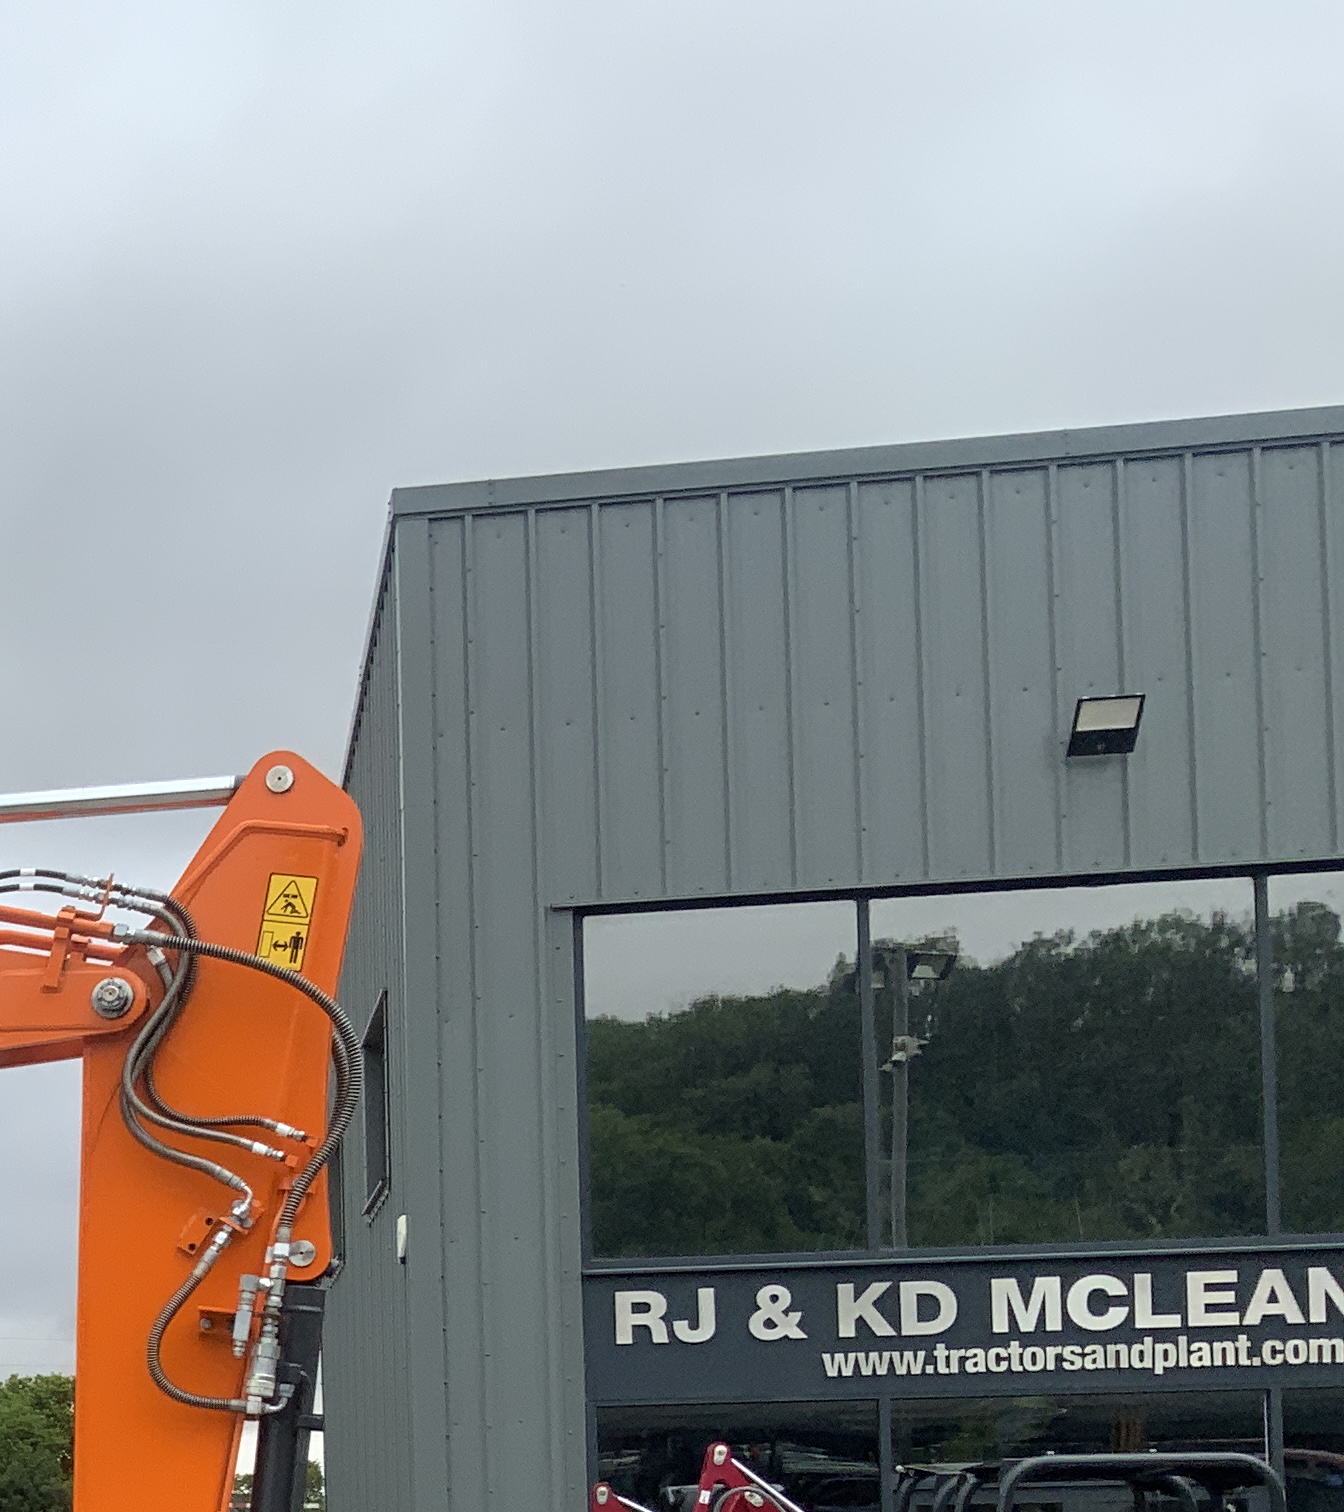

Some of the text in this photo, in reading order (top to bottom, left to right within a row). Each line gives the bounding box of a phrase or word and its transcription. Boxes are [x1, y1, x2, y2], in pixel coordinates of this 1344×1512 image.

[615, 1267, 1344, 1344] RJ & KD MCLEAN
[822, 1334, 1344, 1377] www.tractorsandplant.com
